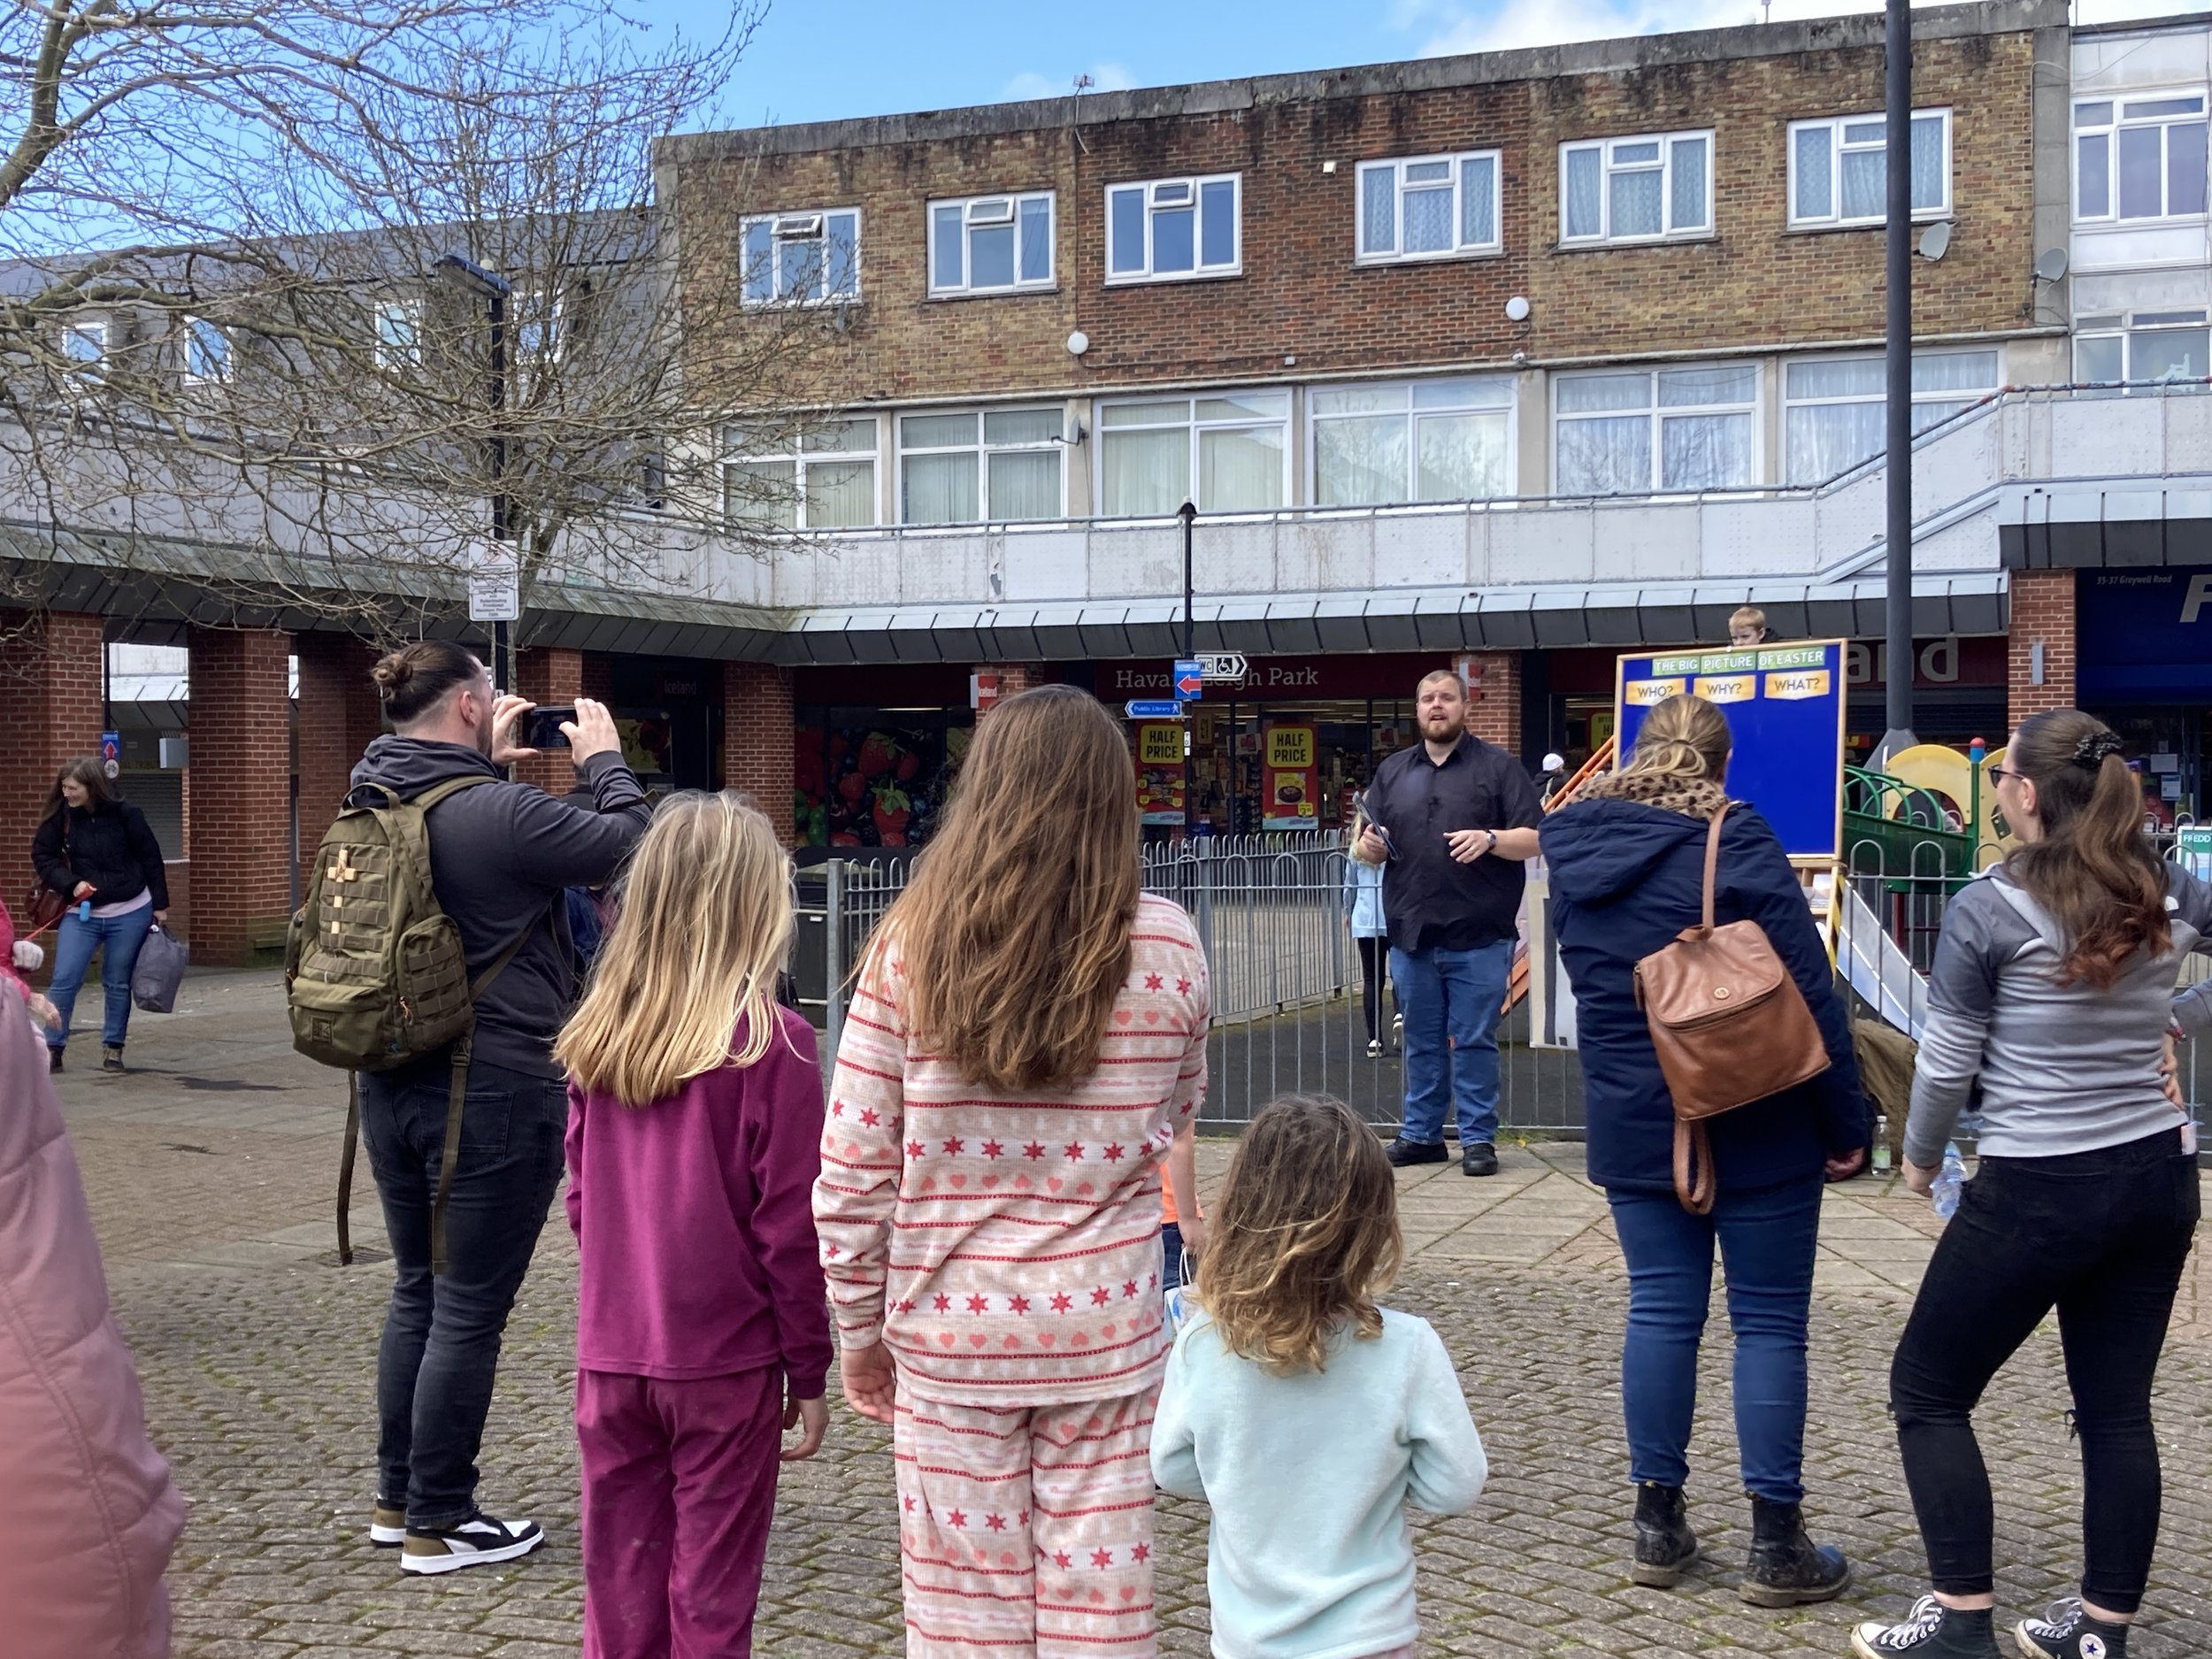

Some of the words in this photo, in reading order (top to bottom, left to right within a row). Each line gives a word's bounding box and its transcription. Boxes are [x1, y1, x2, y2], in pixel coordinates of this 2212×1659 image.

[2153, 574, 2173, 583] Road
[1199, 661, 1212, 670] WC
[1655, 659, 1676, 672] THE
[1678, 657, 1698, 671] BIG
[1703, 655, 1753, 670] PICTURE
[1758, 655, 1776, 666] OF
[1777, 650, 1824, 664] EASTER
[1268, 666, 1318, 686] Park
[664, 680, 697, 695] Iceland
[1706, 683, 1742, 695] WHY?
[1774, 678, 1820, 691] WHAT?
[1637, 686, 1674, 697] WHO?
[1149, 730, 1176, 743] HALF
[1276, 733, 1304, 747] HALF
[1146, 745, 1178, 758] PRICE
[1274, 749, 1307, 762] PRICE
